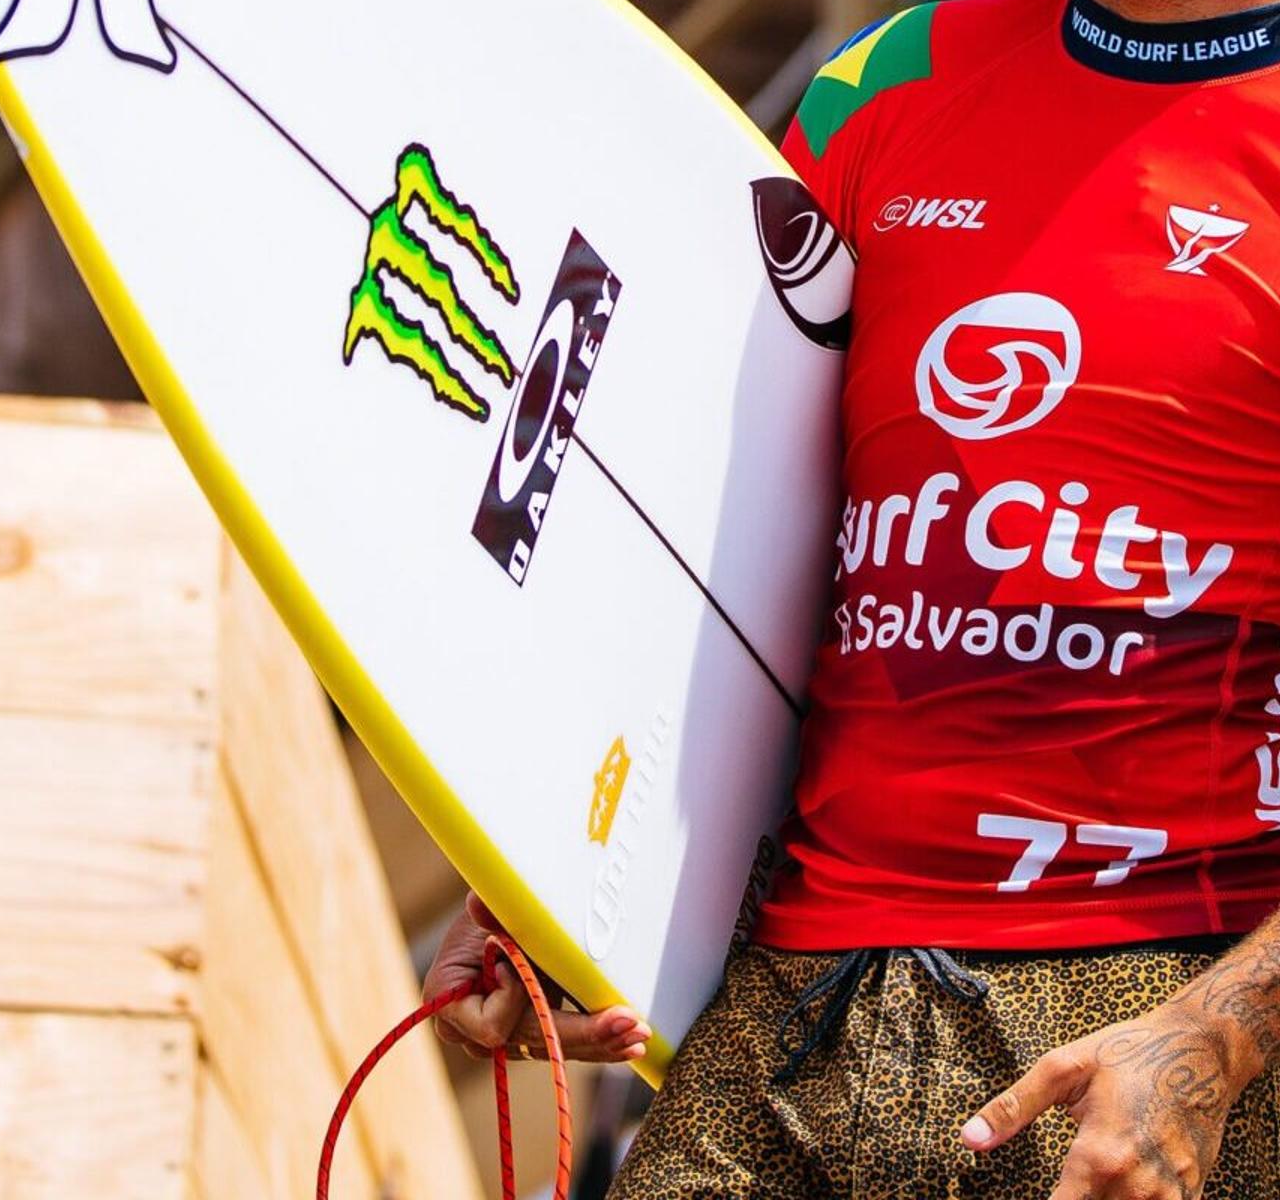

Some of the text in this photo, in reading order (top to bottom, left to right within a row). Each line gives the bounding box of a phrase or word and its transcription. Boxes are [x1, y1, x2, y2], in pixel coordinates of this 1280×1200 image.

[1072, 6, 1271, 63] WORLD SURF LEAGUE
[906, 198, 988, 229] WSL
[508, 272, 617, 584] OAKLEY
[964, 479, 1234, 618] City
[855, 590, 1145, 676] Salvador
[977, 812, 1168, 893] 77
